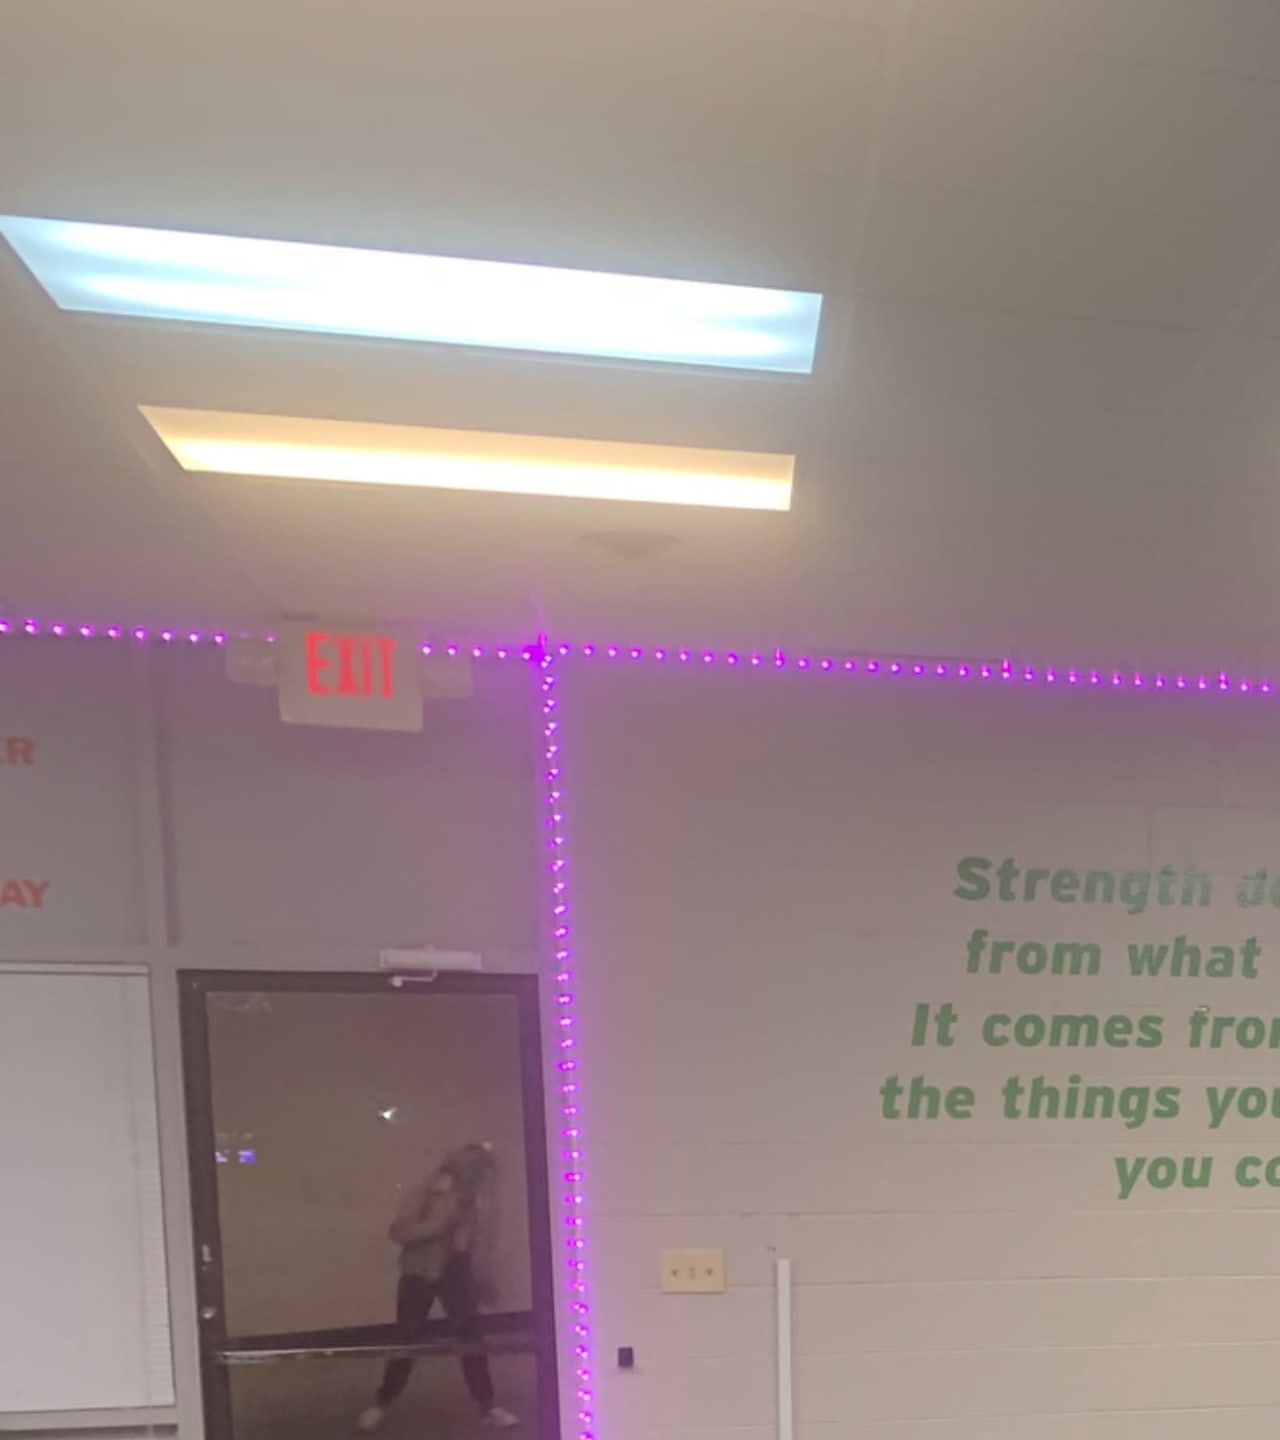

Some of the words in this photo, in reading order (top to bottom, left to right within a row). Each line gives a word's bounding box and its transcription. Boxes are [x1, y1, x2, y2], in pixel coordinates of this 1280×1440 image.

[307, 633, 396, 698] EXIT
[0, 737, 34, 766] R
[955, 856, 1212, 913] Strength
[966, 928, 1101, 976] from
[1127, 936, 1260, 978] what
[911, 1002, 956, 1048] It
[982, 1013, 1164, 1048] comes
[880, 1074, 976, 1121] the
[1001, 1074, 1181, 1130] things
[1113, 1154, 1215, 1201] you
